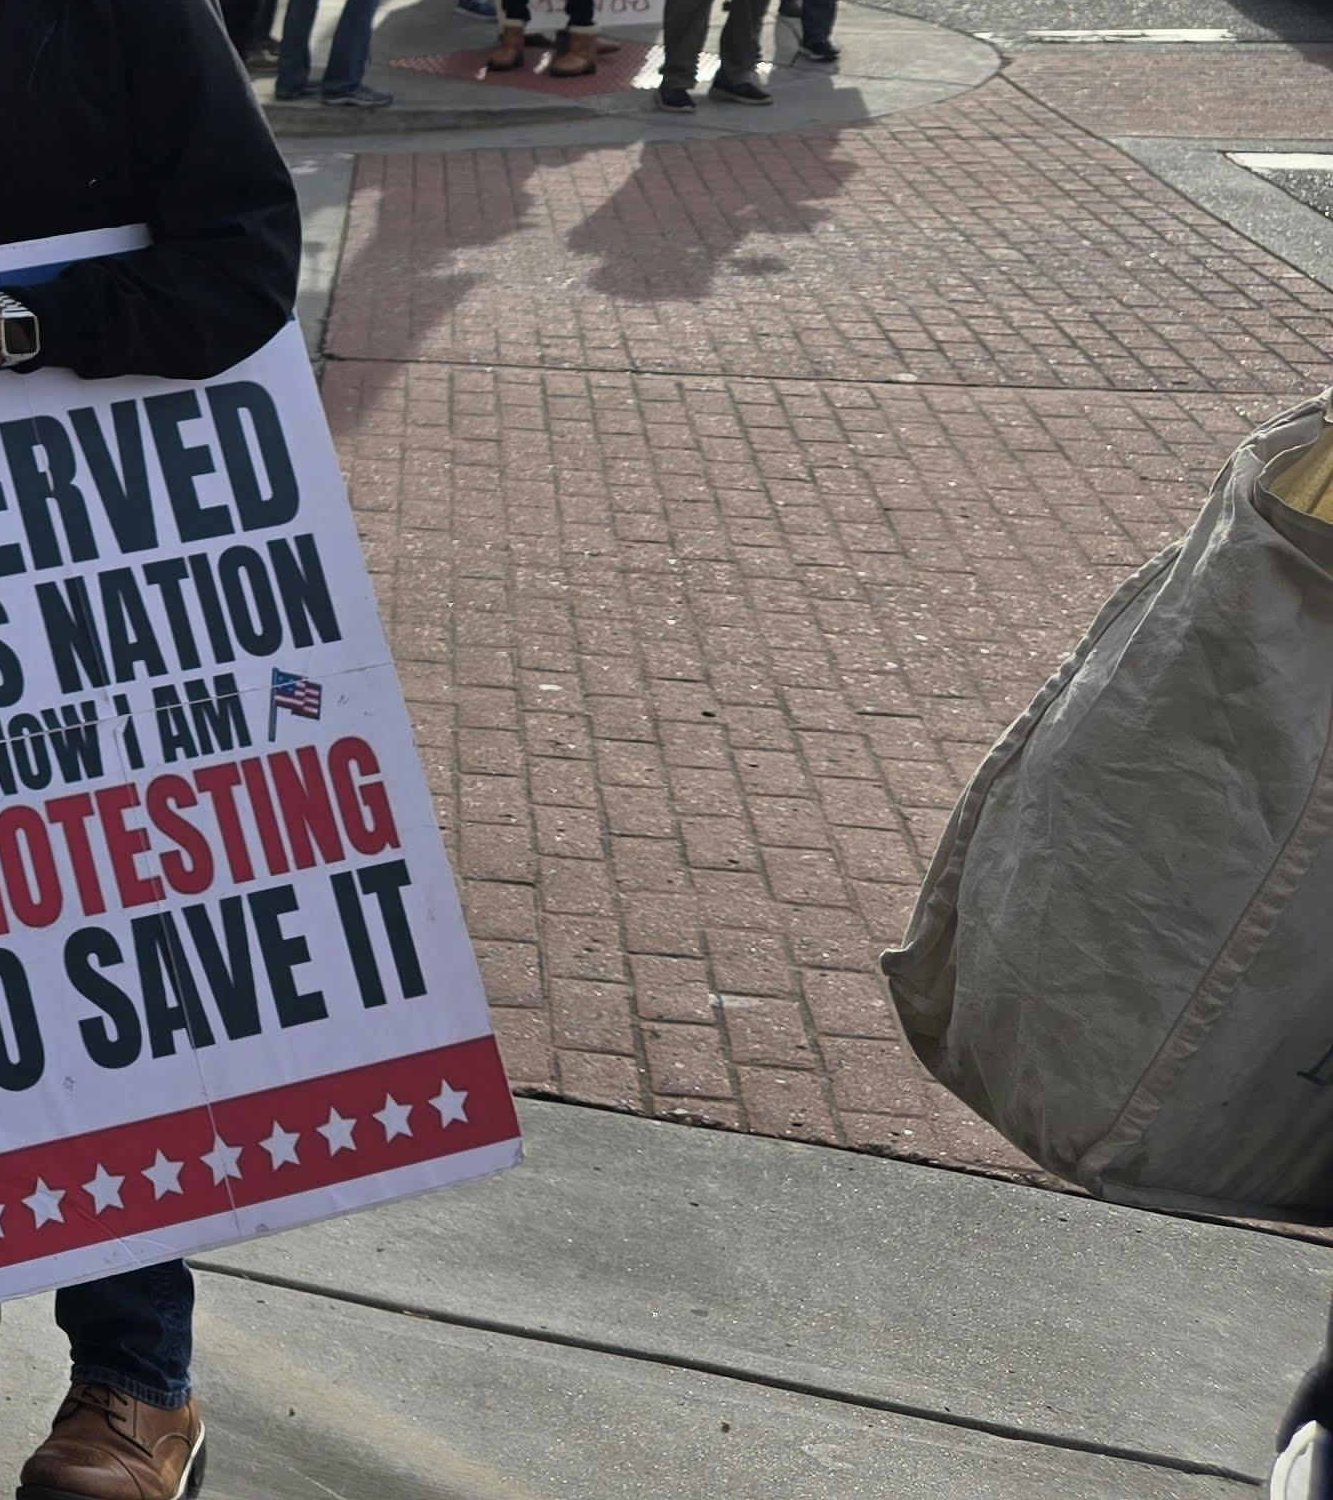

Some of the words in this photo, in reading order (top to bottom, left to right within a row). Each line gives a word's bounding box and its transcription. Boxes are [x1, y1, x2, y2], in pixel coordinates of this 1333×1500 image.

[34, 533, 342, 694] NATION
[112, 693, 145, 771] I
[152, 672, 253, 764] AM
[63, 884, 330, 1070] SAVE
[329, 858, 428, 1011] IT
